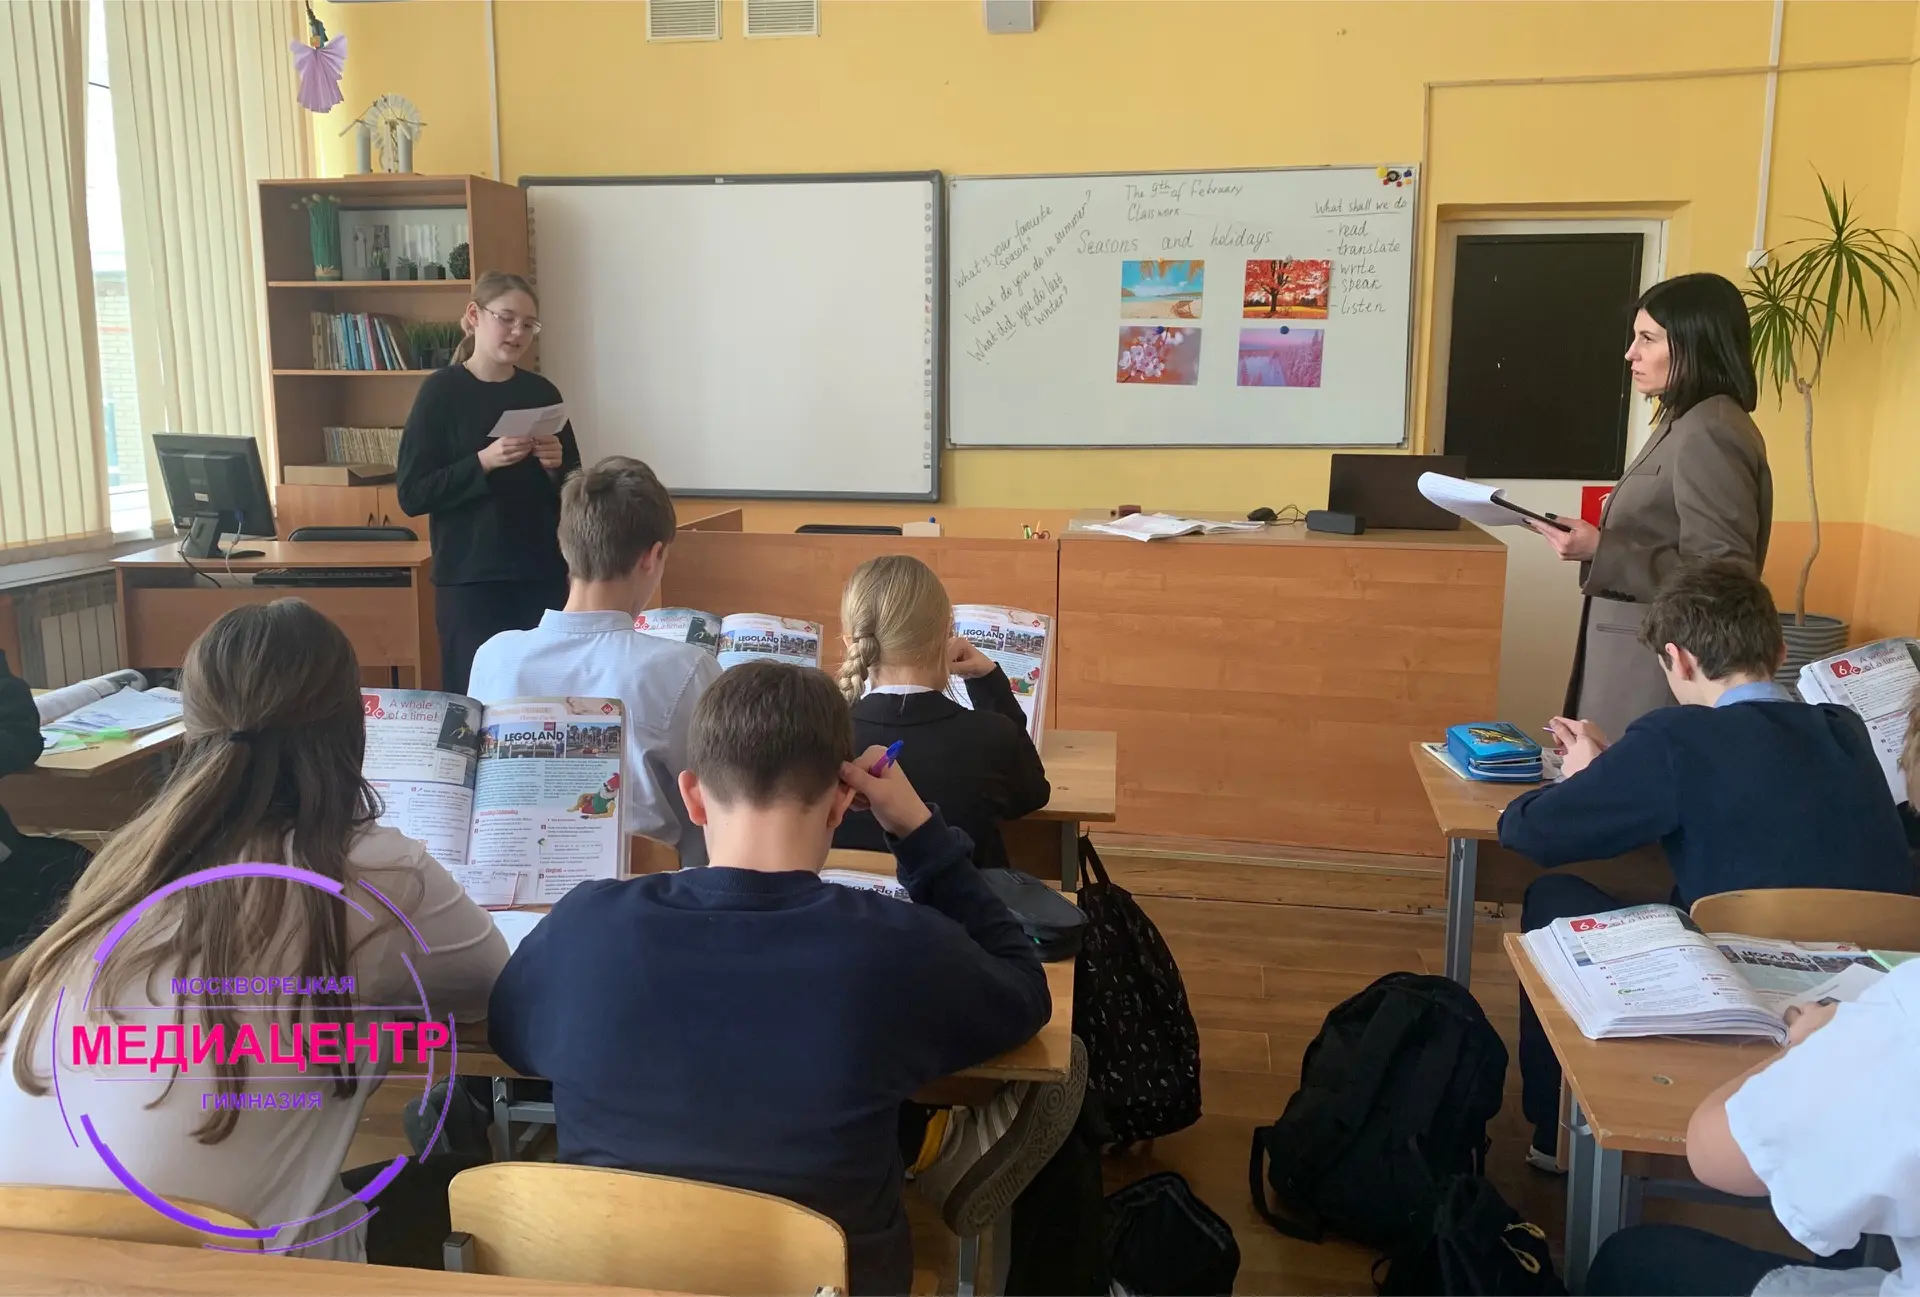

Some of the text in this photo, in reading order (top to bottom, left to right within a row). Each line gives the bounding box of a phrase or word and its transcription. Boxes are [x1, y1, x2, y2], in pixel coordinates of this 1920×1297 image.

[1126, 177, 1243, 202] The 9th of February
[1315, 196, 1408, 214] What shall we do
[1339, 220, 1369, 238] read
[954, 204, 1053, 288] What is your favourite
[1077, 222, 1273, 255] Seasons and holidays
[1337, 238, 1401, 256] translate
[1000, 236, 1031, 270] season?
[1340, 257, 1376, 275] write
[964, 295, 997, 325] What
[1000, 285, 1013, 301] do
[1012, 270, 1030, 297] you
[1033, 256, 1044, 271] do
[1044, 245, 1056, 257] in
[1341, 278, 1382, 293] speak
[1034, 285, 1068, 325] winter?
[1341, 295, 1386, 315] listen
[967, 272, 1063, 361] What did you do last
[738, 634, 780, 644] LEGOLAND
[963, 629, 1005, 640] LEGOLAND
[1860, 647, 1896, 664] A whale
[1840, 665, 1848, 675] 6
[389, 699, 433, 710] A whale
[388, 709, 438, 722] of a time!
[504, 731, 565, 742] LEGOLAND
[1580, 921, 1589, 930] 6
